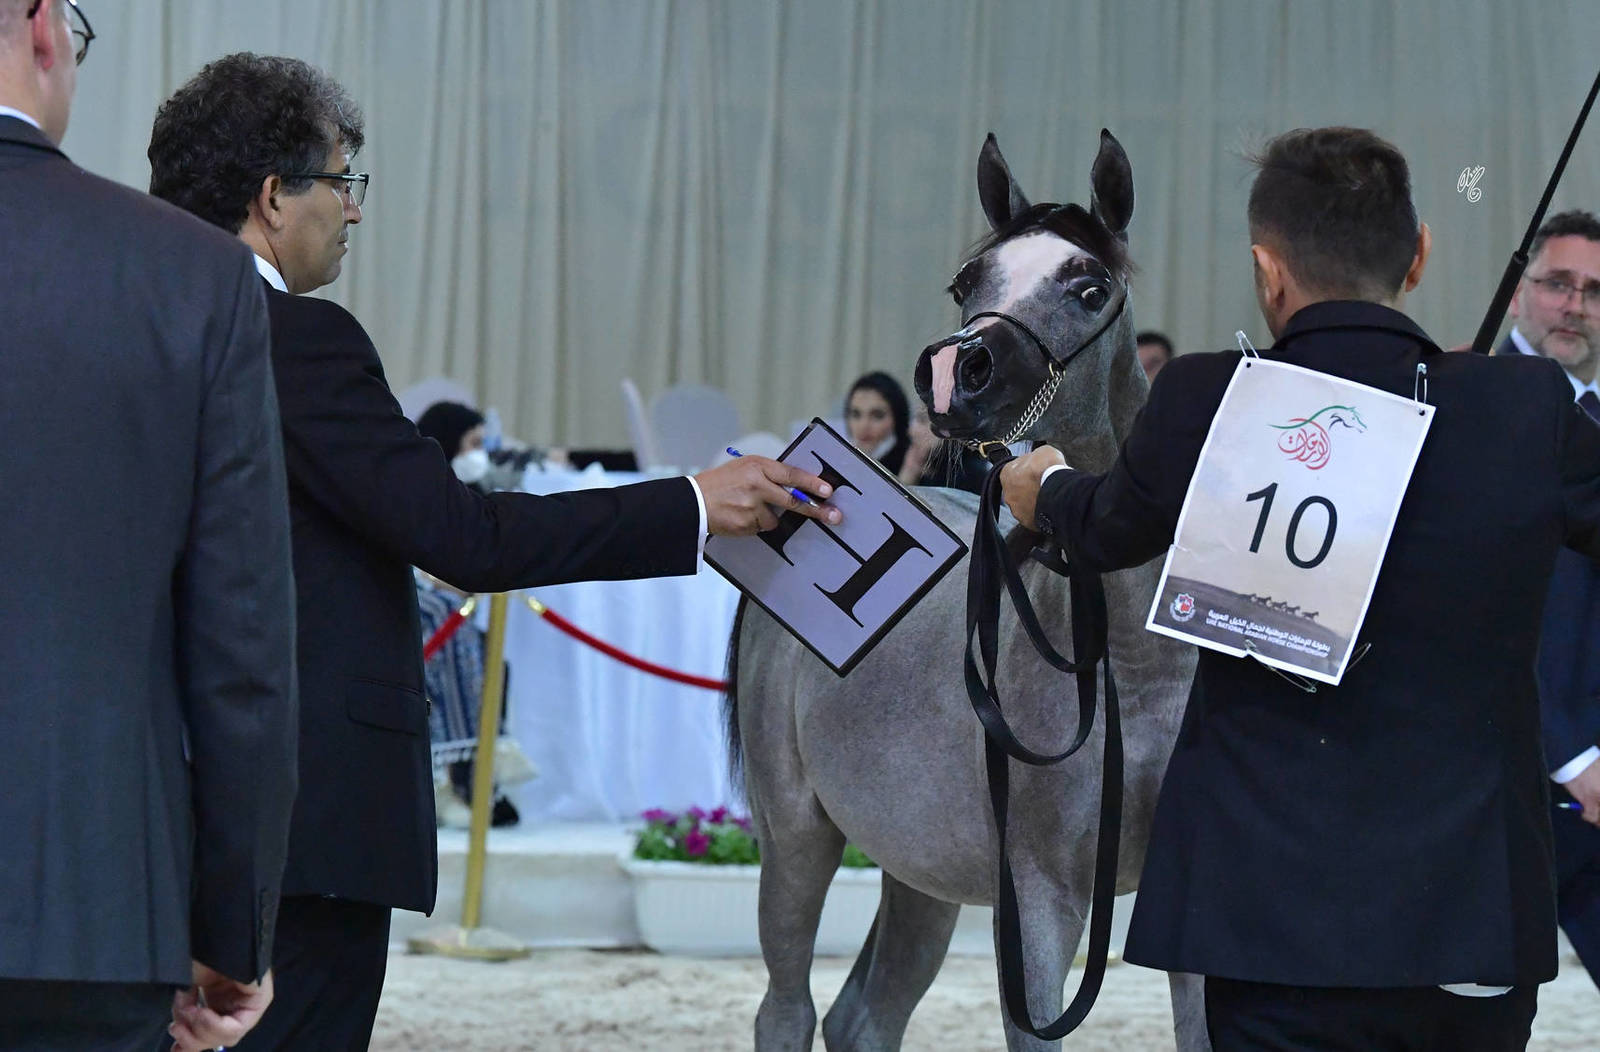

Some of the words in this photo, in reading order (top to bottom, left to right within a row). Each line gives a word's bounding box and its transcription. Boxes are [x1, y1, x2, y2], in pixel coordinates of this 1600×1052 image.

[757, 450, 934, 628] H
[1246, 482, 1338, 569] 10
[1217, 620, 1244, 634] NATIONAL
